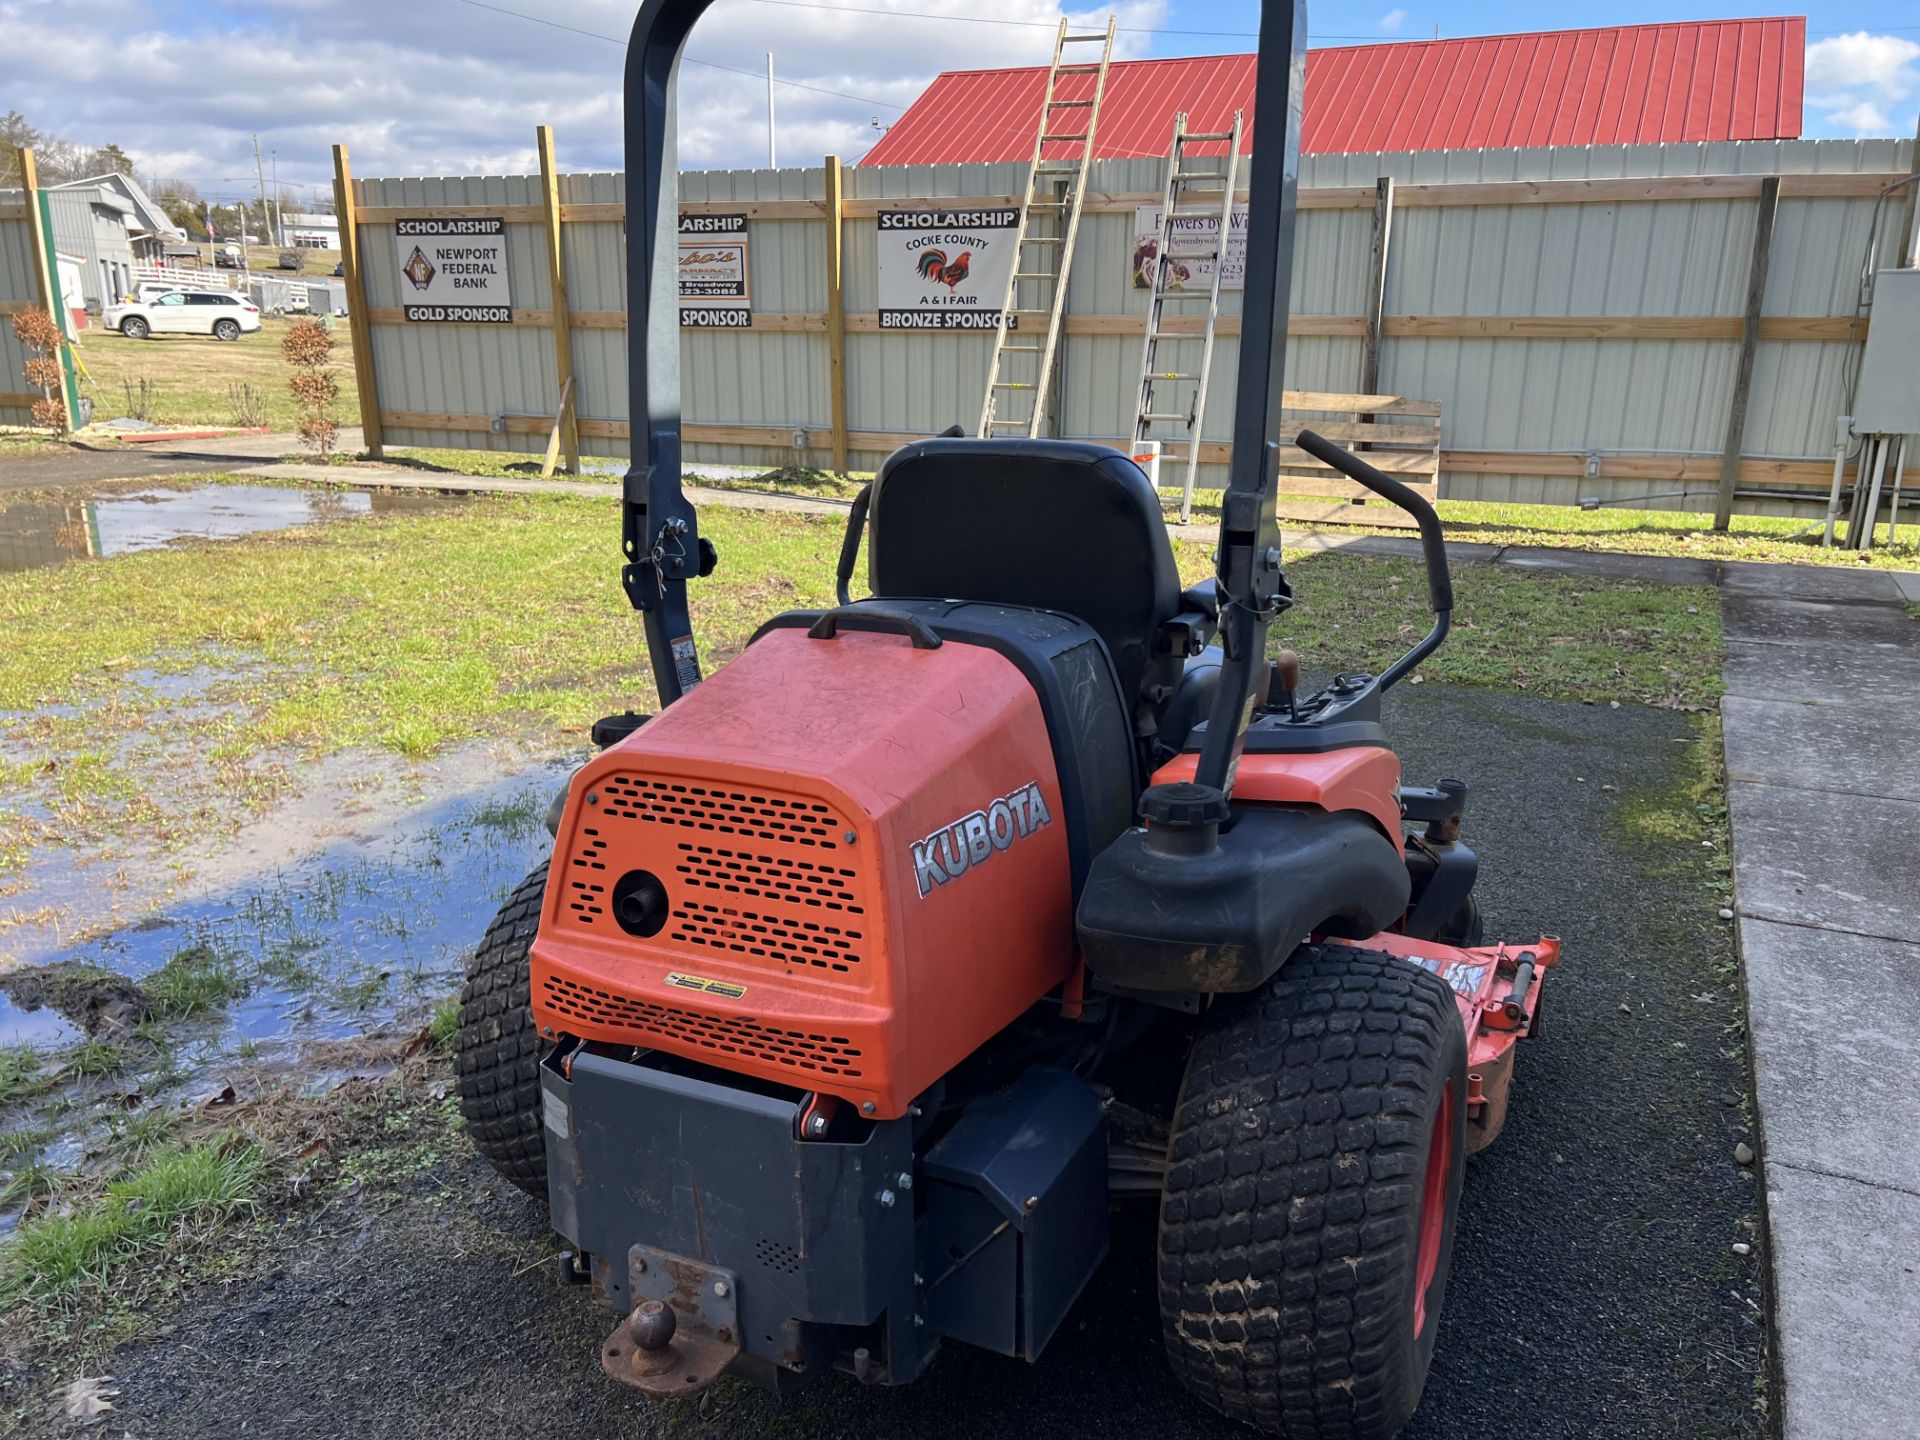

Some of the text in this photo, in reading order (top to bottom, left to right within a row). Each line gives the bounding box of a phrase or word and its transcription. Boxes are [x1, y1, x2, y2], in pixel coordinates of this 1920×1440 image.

[399, 220, 501, 234] SCHOLARSHIP
[882, 212, 1015, 228] SCHOLARSHIP
[906, 234, 989, 251] COCKE COUNTY
[436, 248, 498, 260] NEWPORT
[442, 263, 498, 275] FEDERAL
[453, 278, 488, 289] BANK
[919, 296, 929, 305] A
[931, 296, 940, 305] &
[950, 296, 978, 305] FAIR
[409, 307, 509, 322] GOLD SPONSOR
[682, 310, 748, 326] SPONSOR
[882, 312, 1016, 329] BRONZE SPONSOR
[911, 783, 1051, 896] KUBOTA
